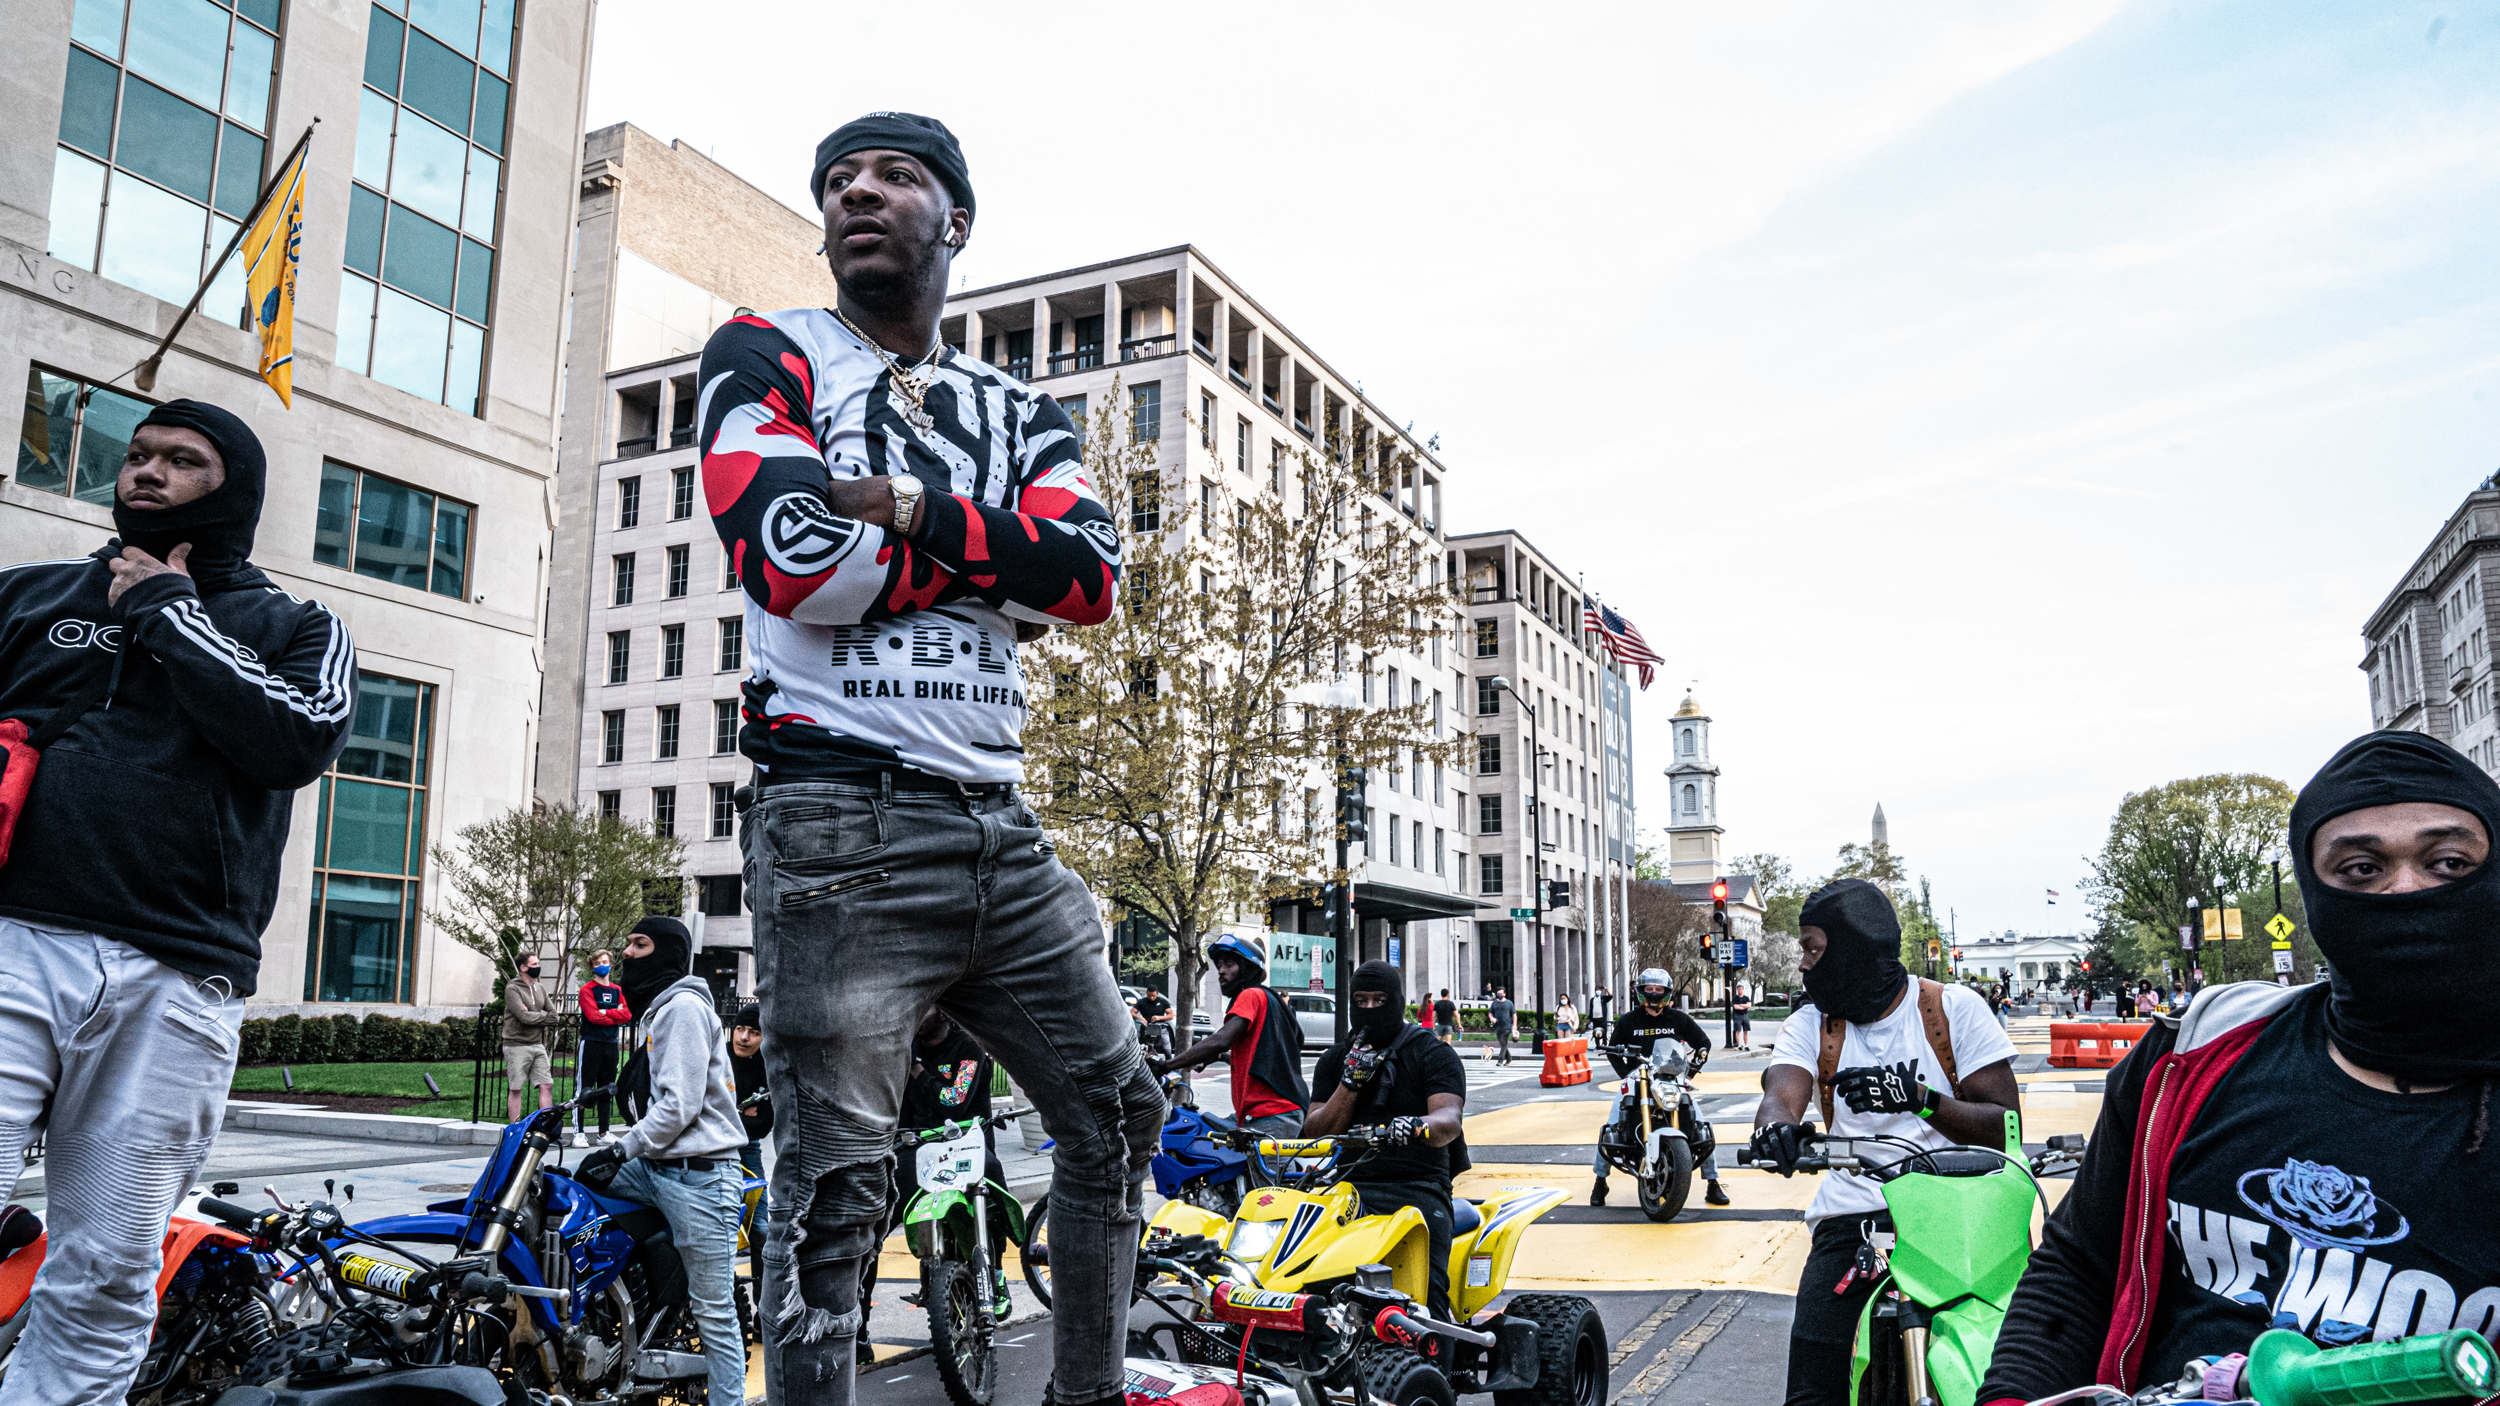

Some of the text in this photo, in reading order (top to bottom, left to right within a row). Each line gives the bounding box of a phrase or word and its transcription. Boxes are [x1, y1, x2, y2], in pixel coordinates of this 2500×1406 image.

[843, 680, 905, 698] REAL
[915, 680, 966, 701] BIKE
[973, 684, 1008, 705] LIFE
[1633, 1027, 1675, 1036] FREEDOM
[1866, 1076, 1884, 1108] FOX
